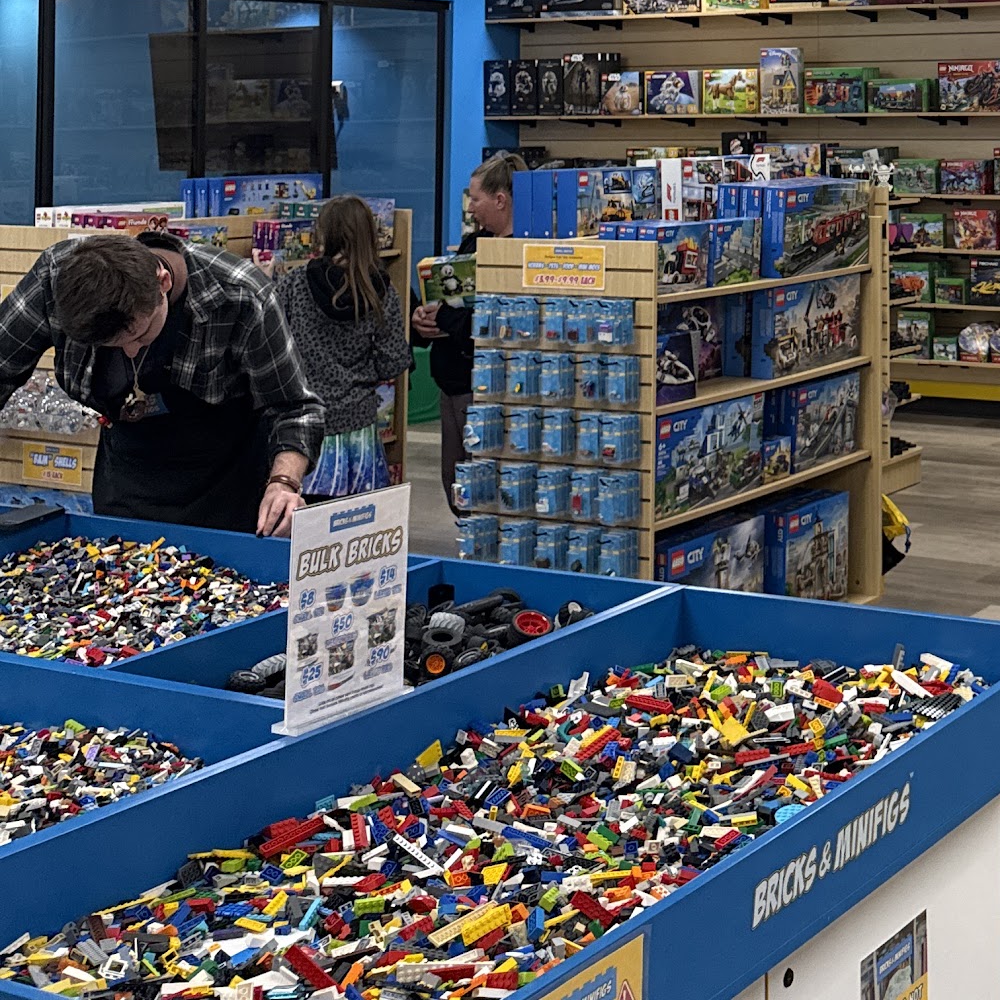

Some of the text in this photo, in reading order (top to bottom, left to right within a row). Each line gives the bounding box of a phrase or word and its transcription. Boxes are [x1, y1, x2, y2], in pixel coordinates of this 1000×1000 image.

[797, 192, 810, 203] CITY
[786, 290, 799, 302] CITY
[673, 418, 689, 433] CITY
[53, 456, 78, 470] SHELLS
[800, 513, 813, 526] CITY
[297, 526, 403, 581] BULK BRICKS
[687, 546, 705, 565] CITY
[380, 565, 397, 586] $14
[300, 589, 316, 610] $8
[333, 613, 353, 635] $50
[370, 646, 390, 667] $90
[302, 663, 323, 686] $25
[752, 781, 911, 930] BRICKS & MINIFIGS
